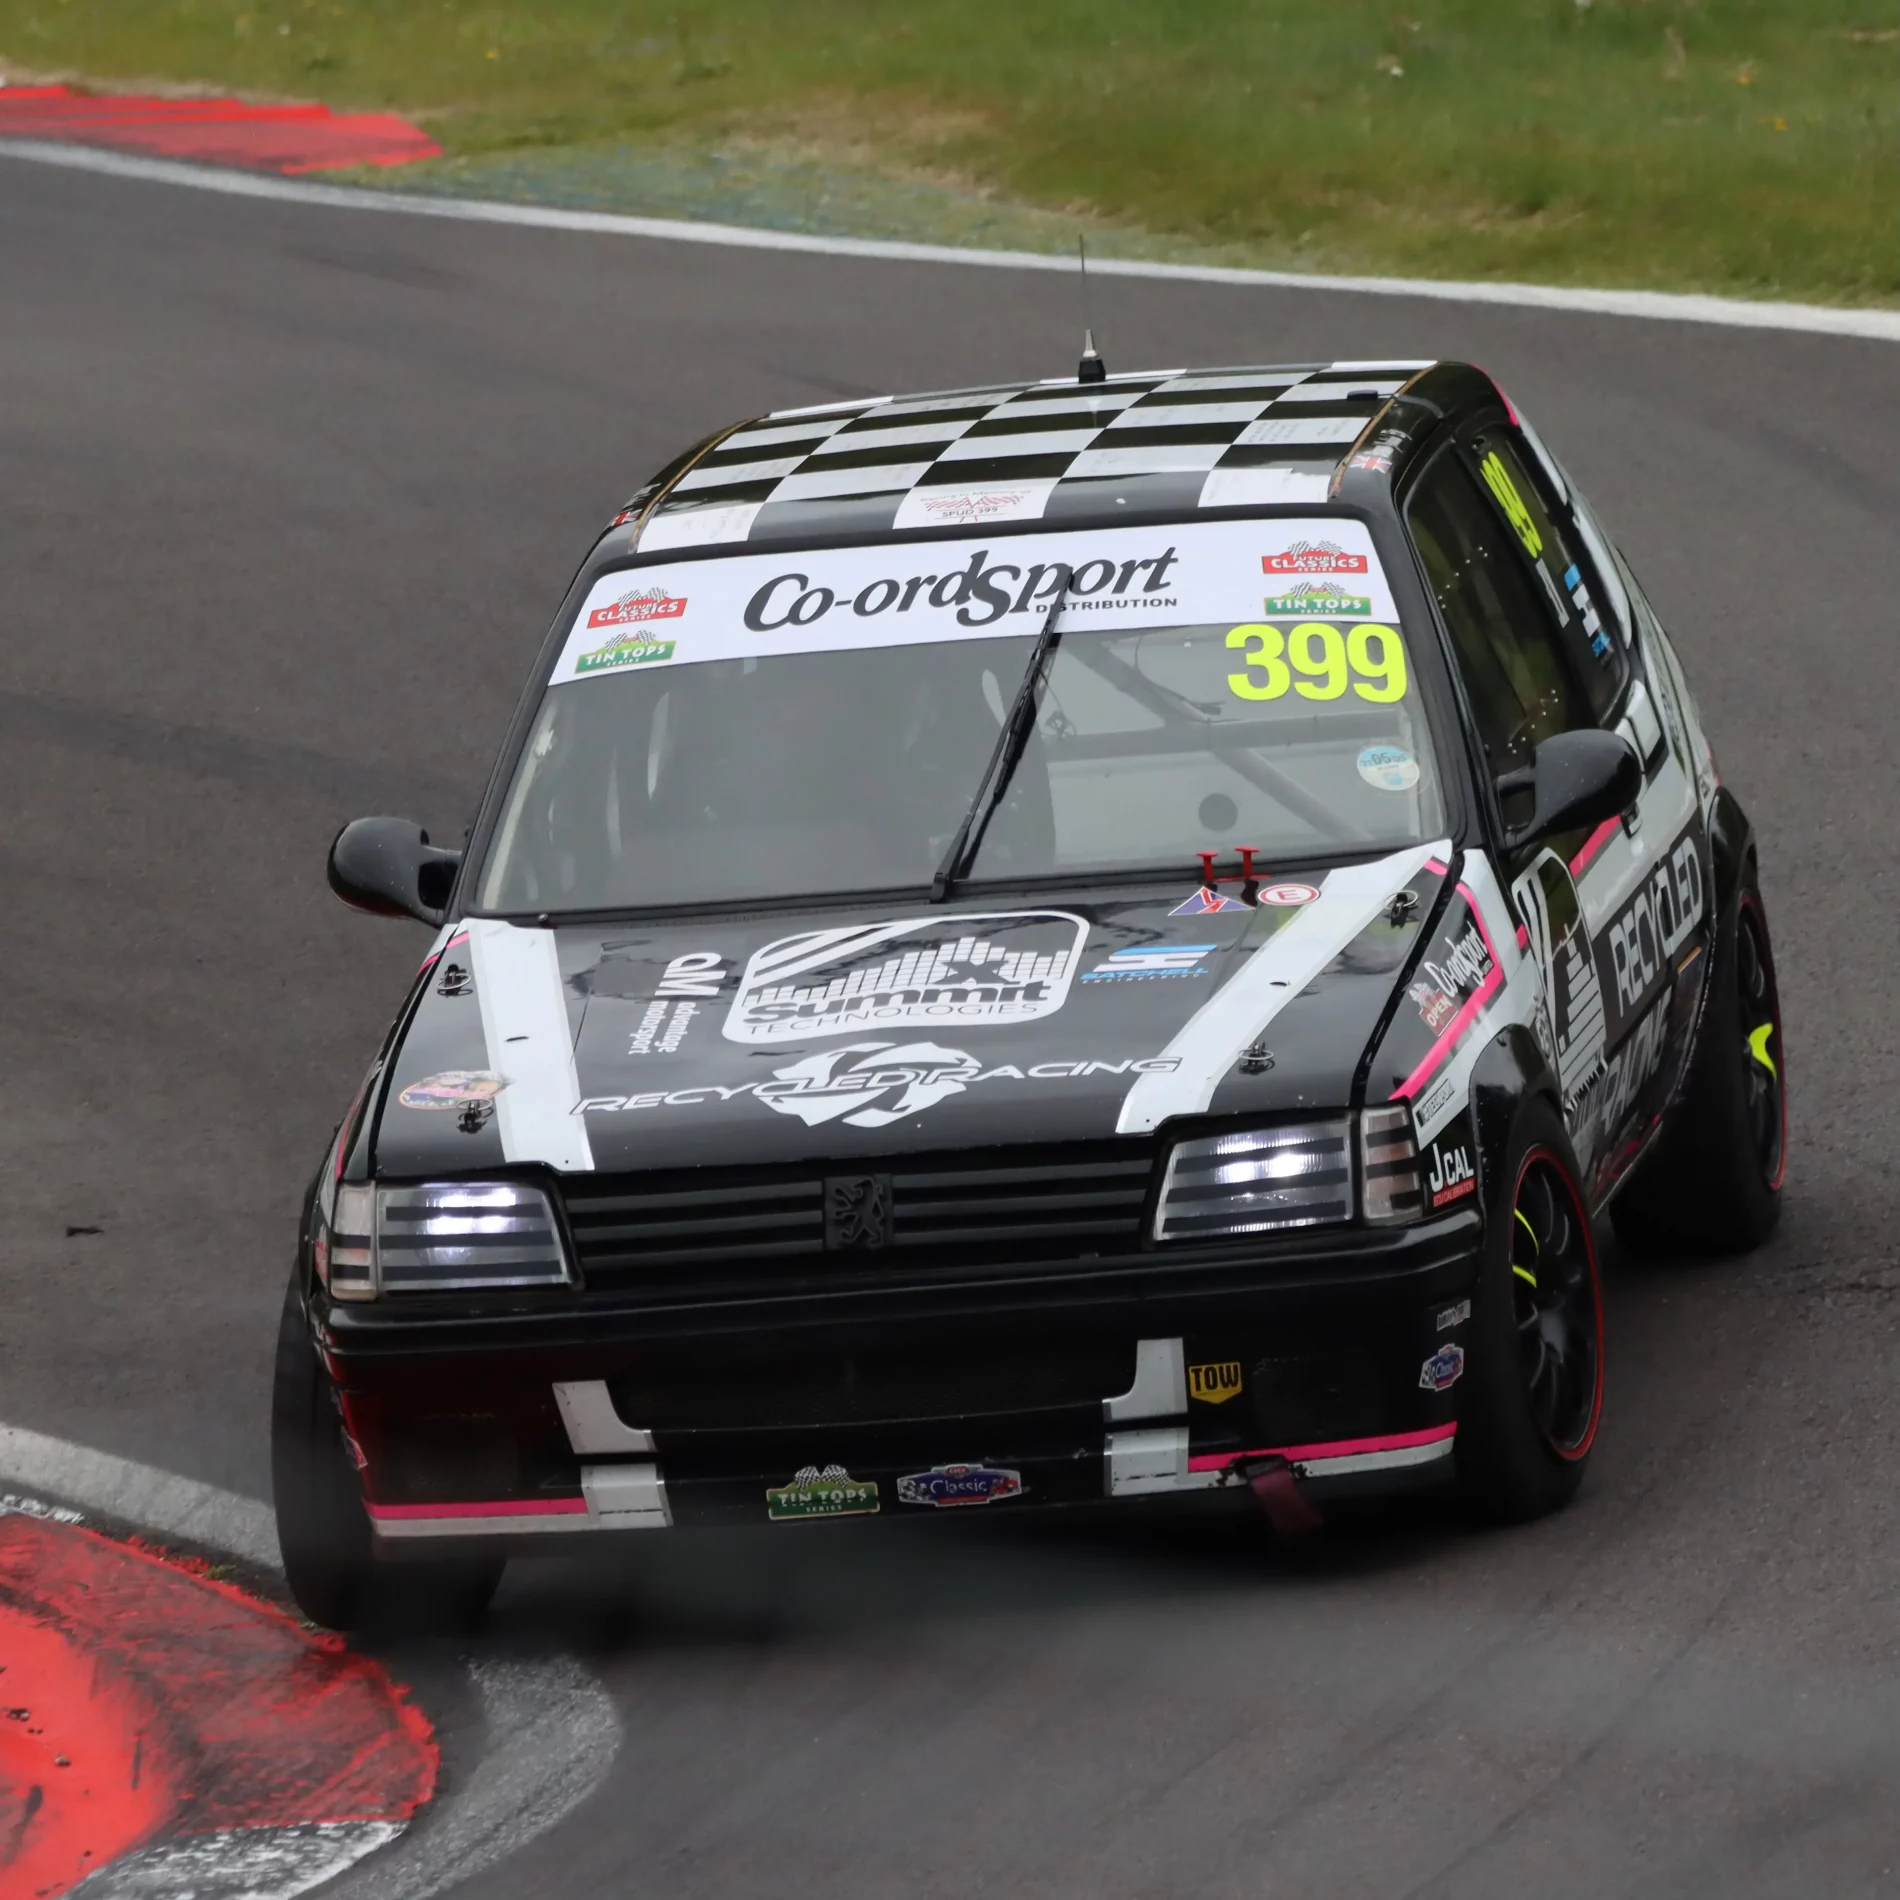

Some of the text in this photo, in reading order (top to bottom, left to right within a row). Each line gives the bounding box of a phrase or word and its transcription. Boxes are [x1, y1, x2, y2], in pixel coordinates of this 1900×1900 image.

[942, 509, 974, 518] SPUD
[1270, 557, 1360, 569] CLASSICS
[597, 600, 679, 622] CLASSICS
[1273, 599, 1362, 610] TIN TOPS
[585, 643, 666, 666] TIN TOPS
[1224, 622, 1407, 703] 399
[1608, 835, 1704, 1018] RECYCLED
[1079, 967, 1209, 981] SATCHELL
[750, 1002, 1038, 1036] TECHNOLOGIES
[1426, 995, 1453, 1028] OPEN
[626, 1000, 670, 1056] motorsport
[653, 1001, 701, 1054] advantage
[1191, 1363, 1239, 1392] TOW
[778, 1487, 868, 1507] TIN TOPS
[930, 1478, 988, 1494] Classic
[806, 1504, 843, 1513] SERIES
